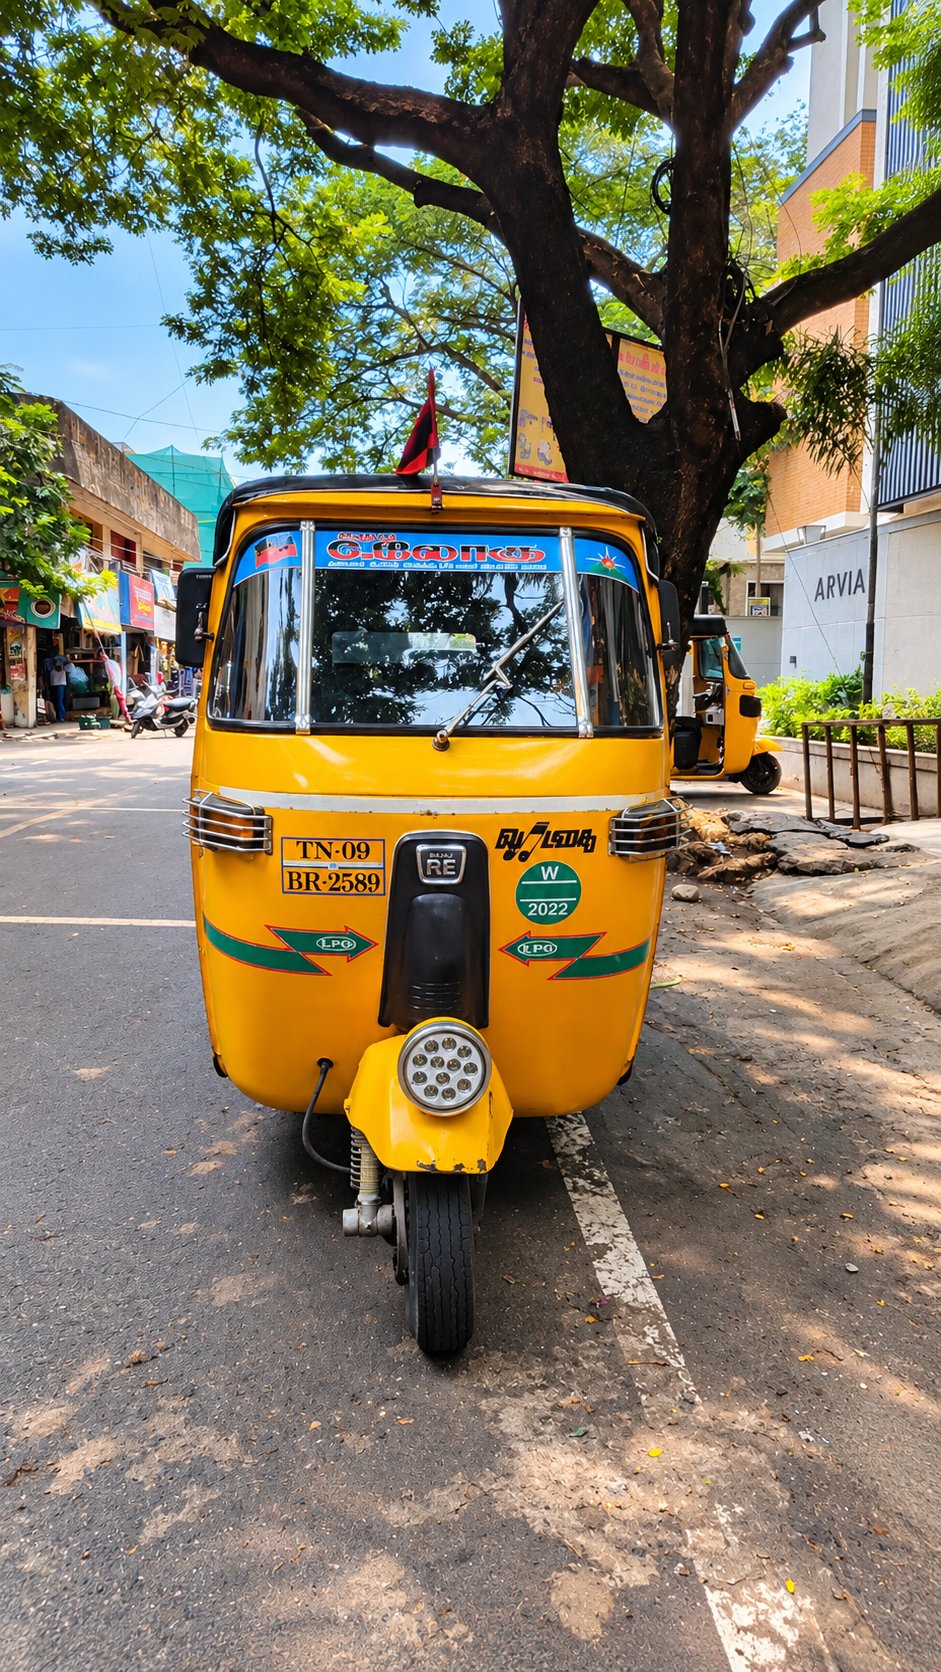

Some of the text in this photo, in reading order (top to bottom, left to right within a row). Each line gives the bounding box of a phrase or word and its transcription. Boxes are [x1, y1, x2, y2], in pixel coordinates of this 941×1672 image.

[814, 568, 865, 602] ARVIA
[296, 840, 370, 860] TN-09
[426, 859, 456, 875] RE
[541, 865, 559, 880] W
[286, 871, 380, 892] BR-2589
[528, 902, 569, 916] 2022
[321, 939, 353, 949] LPG
